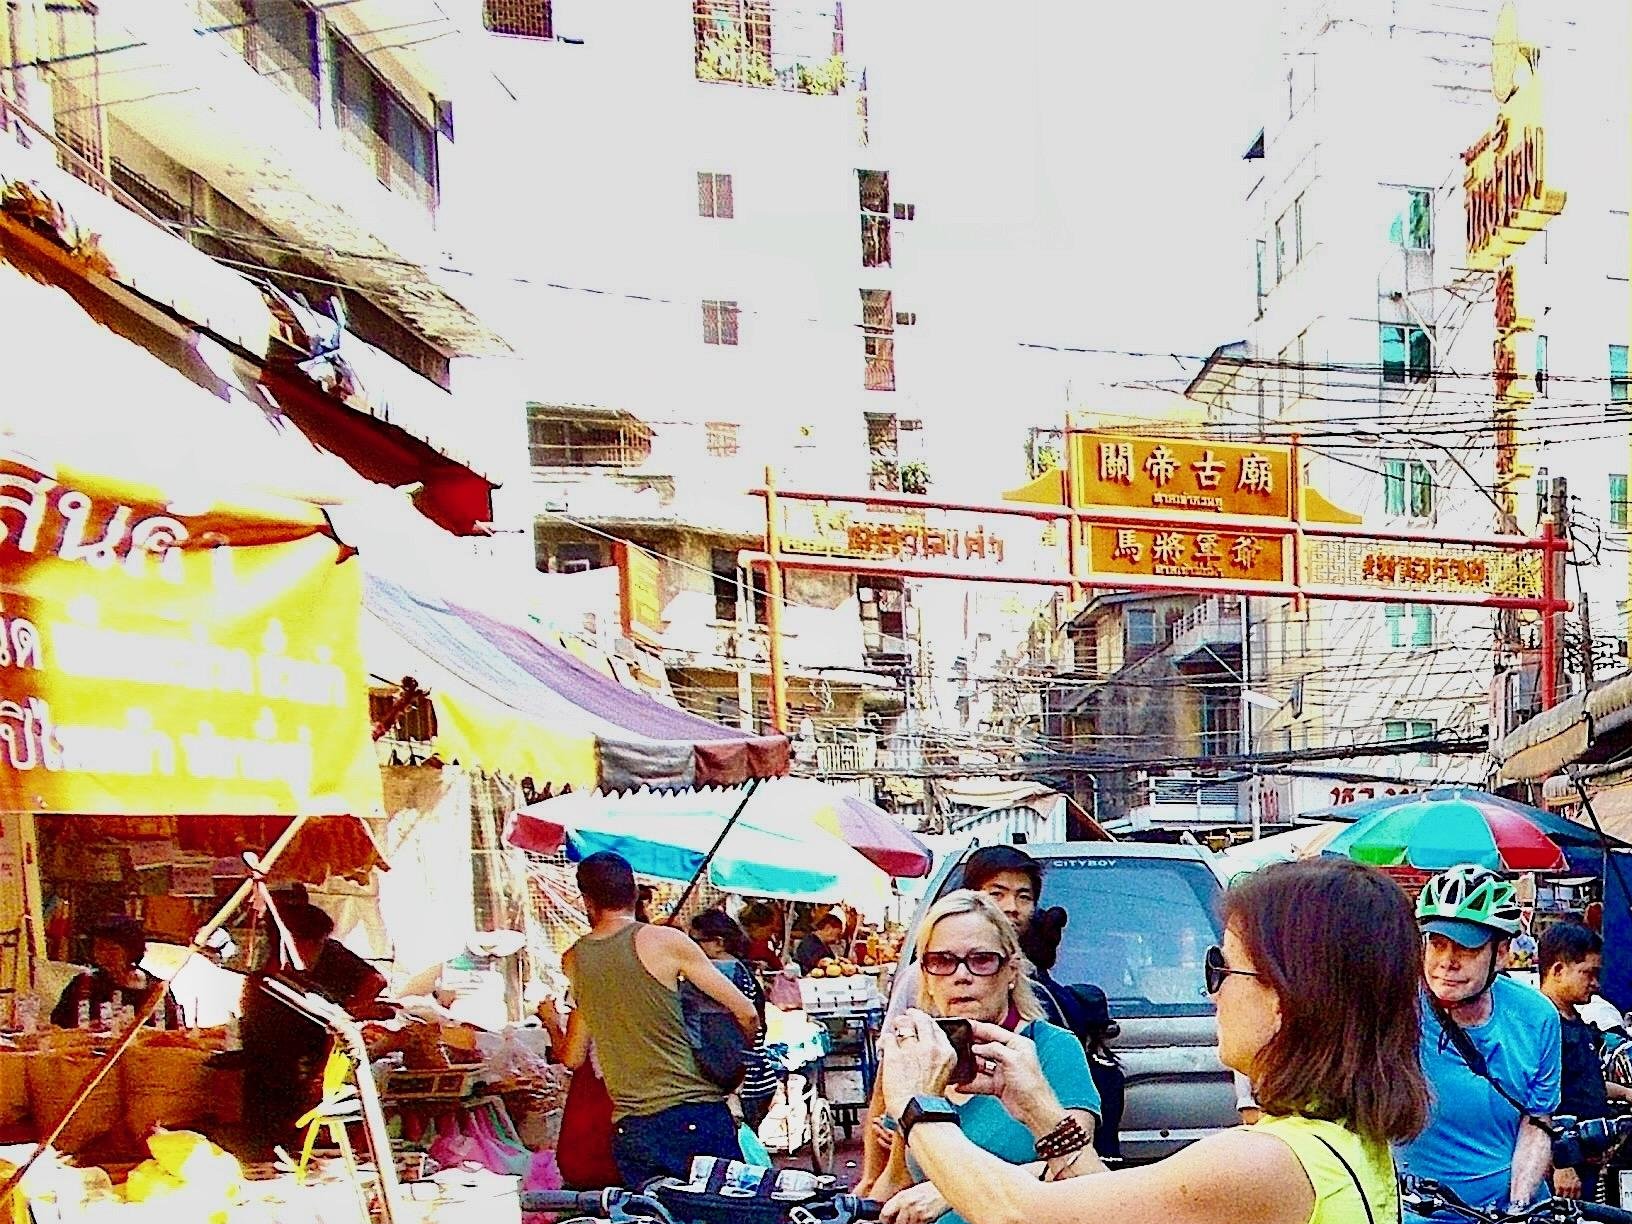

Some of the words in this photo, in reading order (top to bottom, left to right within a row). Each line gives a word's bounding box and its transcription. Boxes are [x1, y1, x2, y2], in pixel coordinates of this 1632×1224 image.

[1098, 442, 1274, 495] 關帝古廟
[1113, 528, 1264, 570] 馬將軍爺
[1053, 859, 1117, 868] CITYBOY
